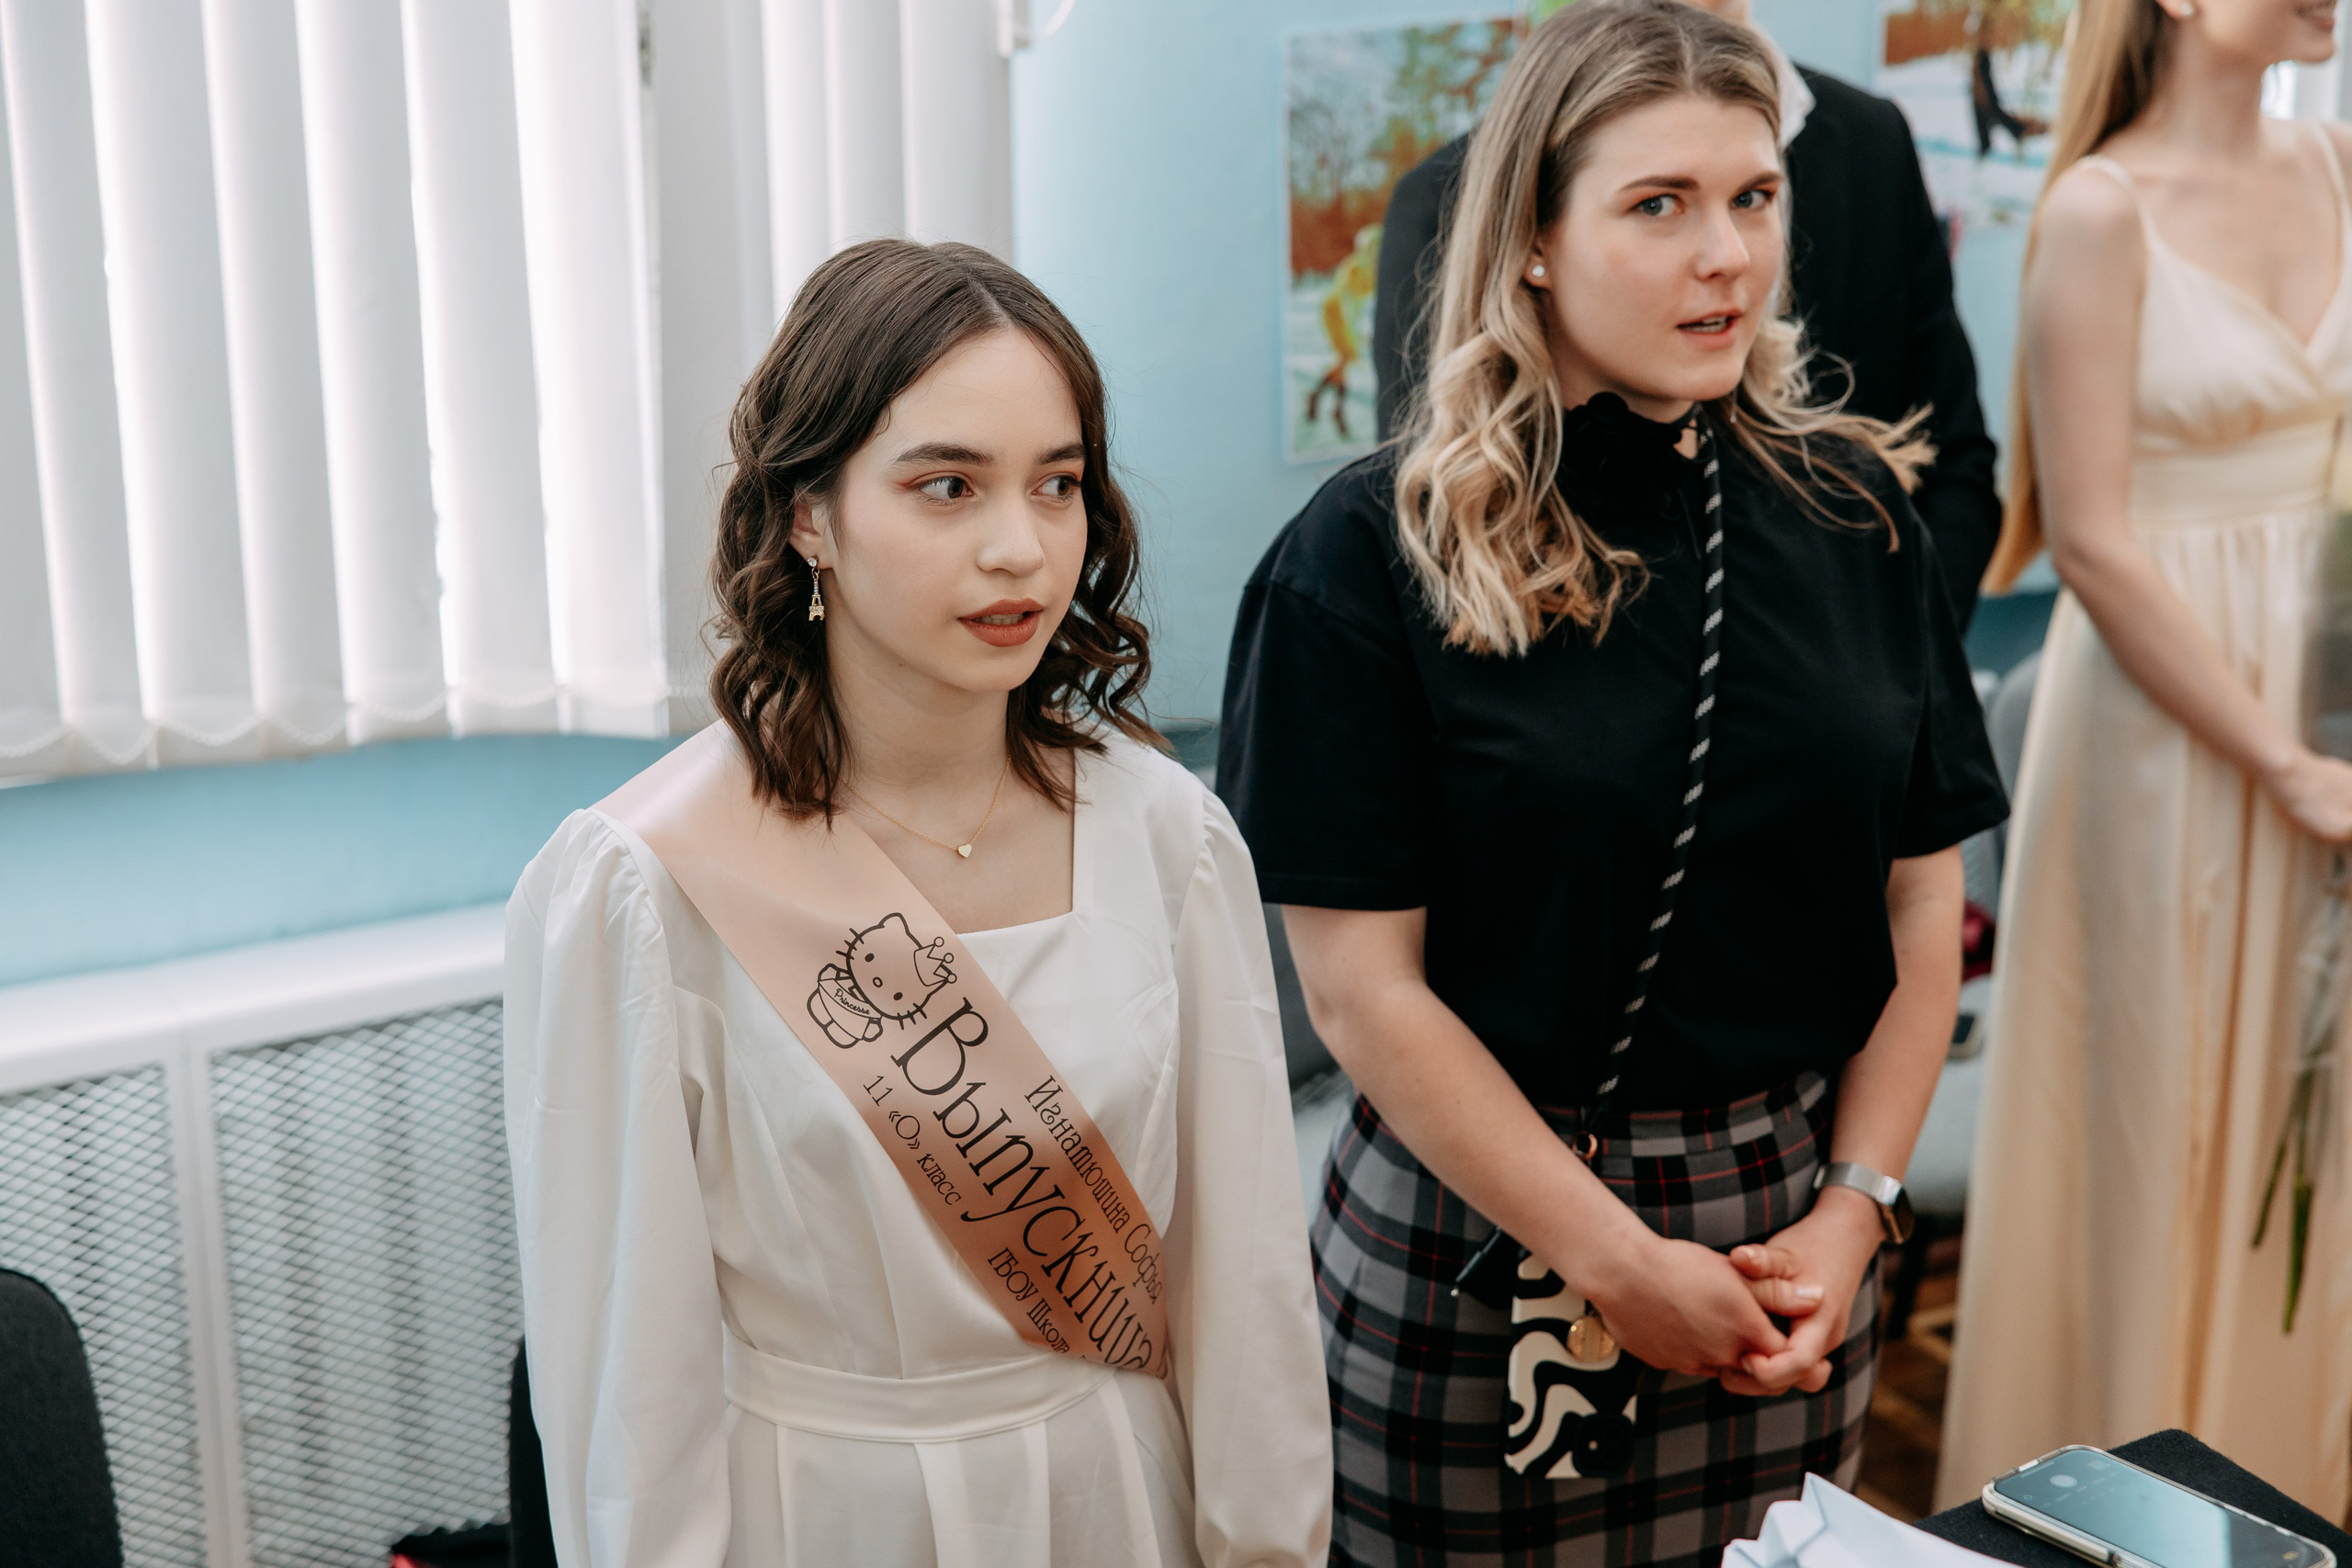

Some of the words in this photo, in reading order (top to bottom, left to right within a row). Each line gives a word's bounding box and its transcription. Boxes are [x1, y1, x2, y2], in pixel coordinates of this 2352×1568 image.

[863, 1075, 893, 1106] 11
[917, 1153, 963, 1206] класс
[1024, 1075, 1130, 1233] Игнатюшина
[988, 1247, 1038, 1301] ГБОУ
